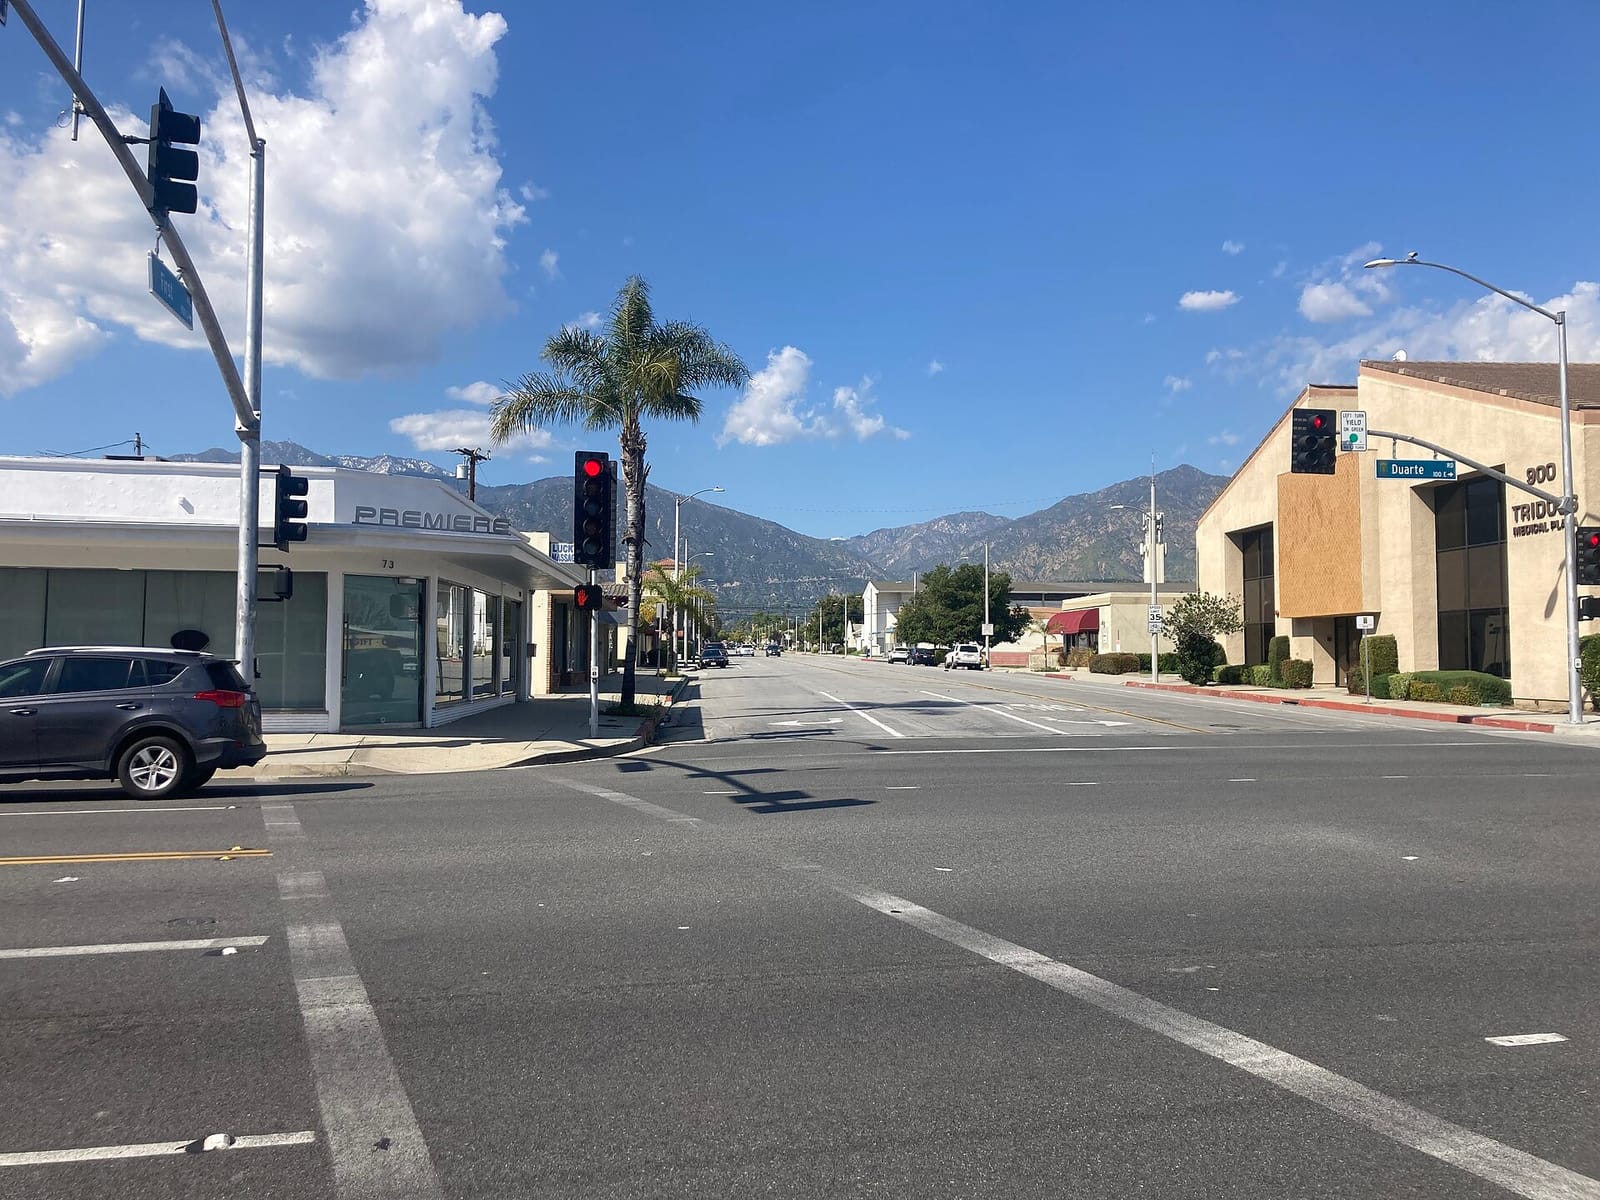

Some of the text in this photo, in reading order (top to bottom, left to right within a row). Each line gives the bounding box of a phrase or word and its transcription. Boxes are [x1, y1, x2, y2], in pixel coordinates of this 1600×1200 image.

[1391, 464, 1424, 475] Duarte
[1527, 463, 1556, 485] 900
[355, 506, 511, 535] PREMIERE
[1512, 522, 1549, 538] MEDICAL
[552, 543, 574, 553] LUCK
[381, 559, 394, 568] 73
